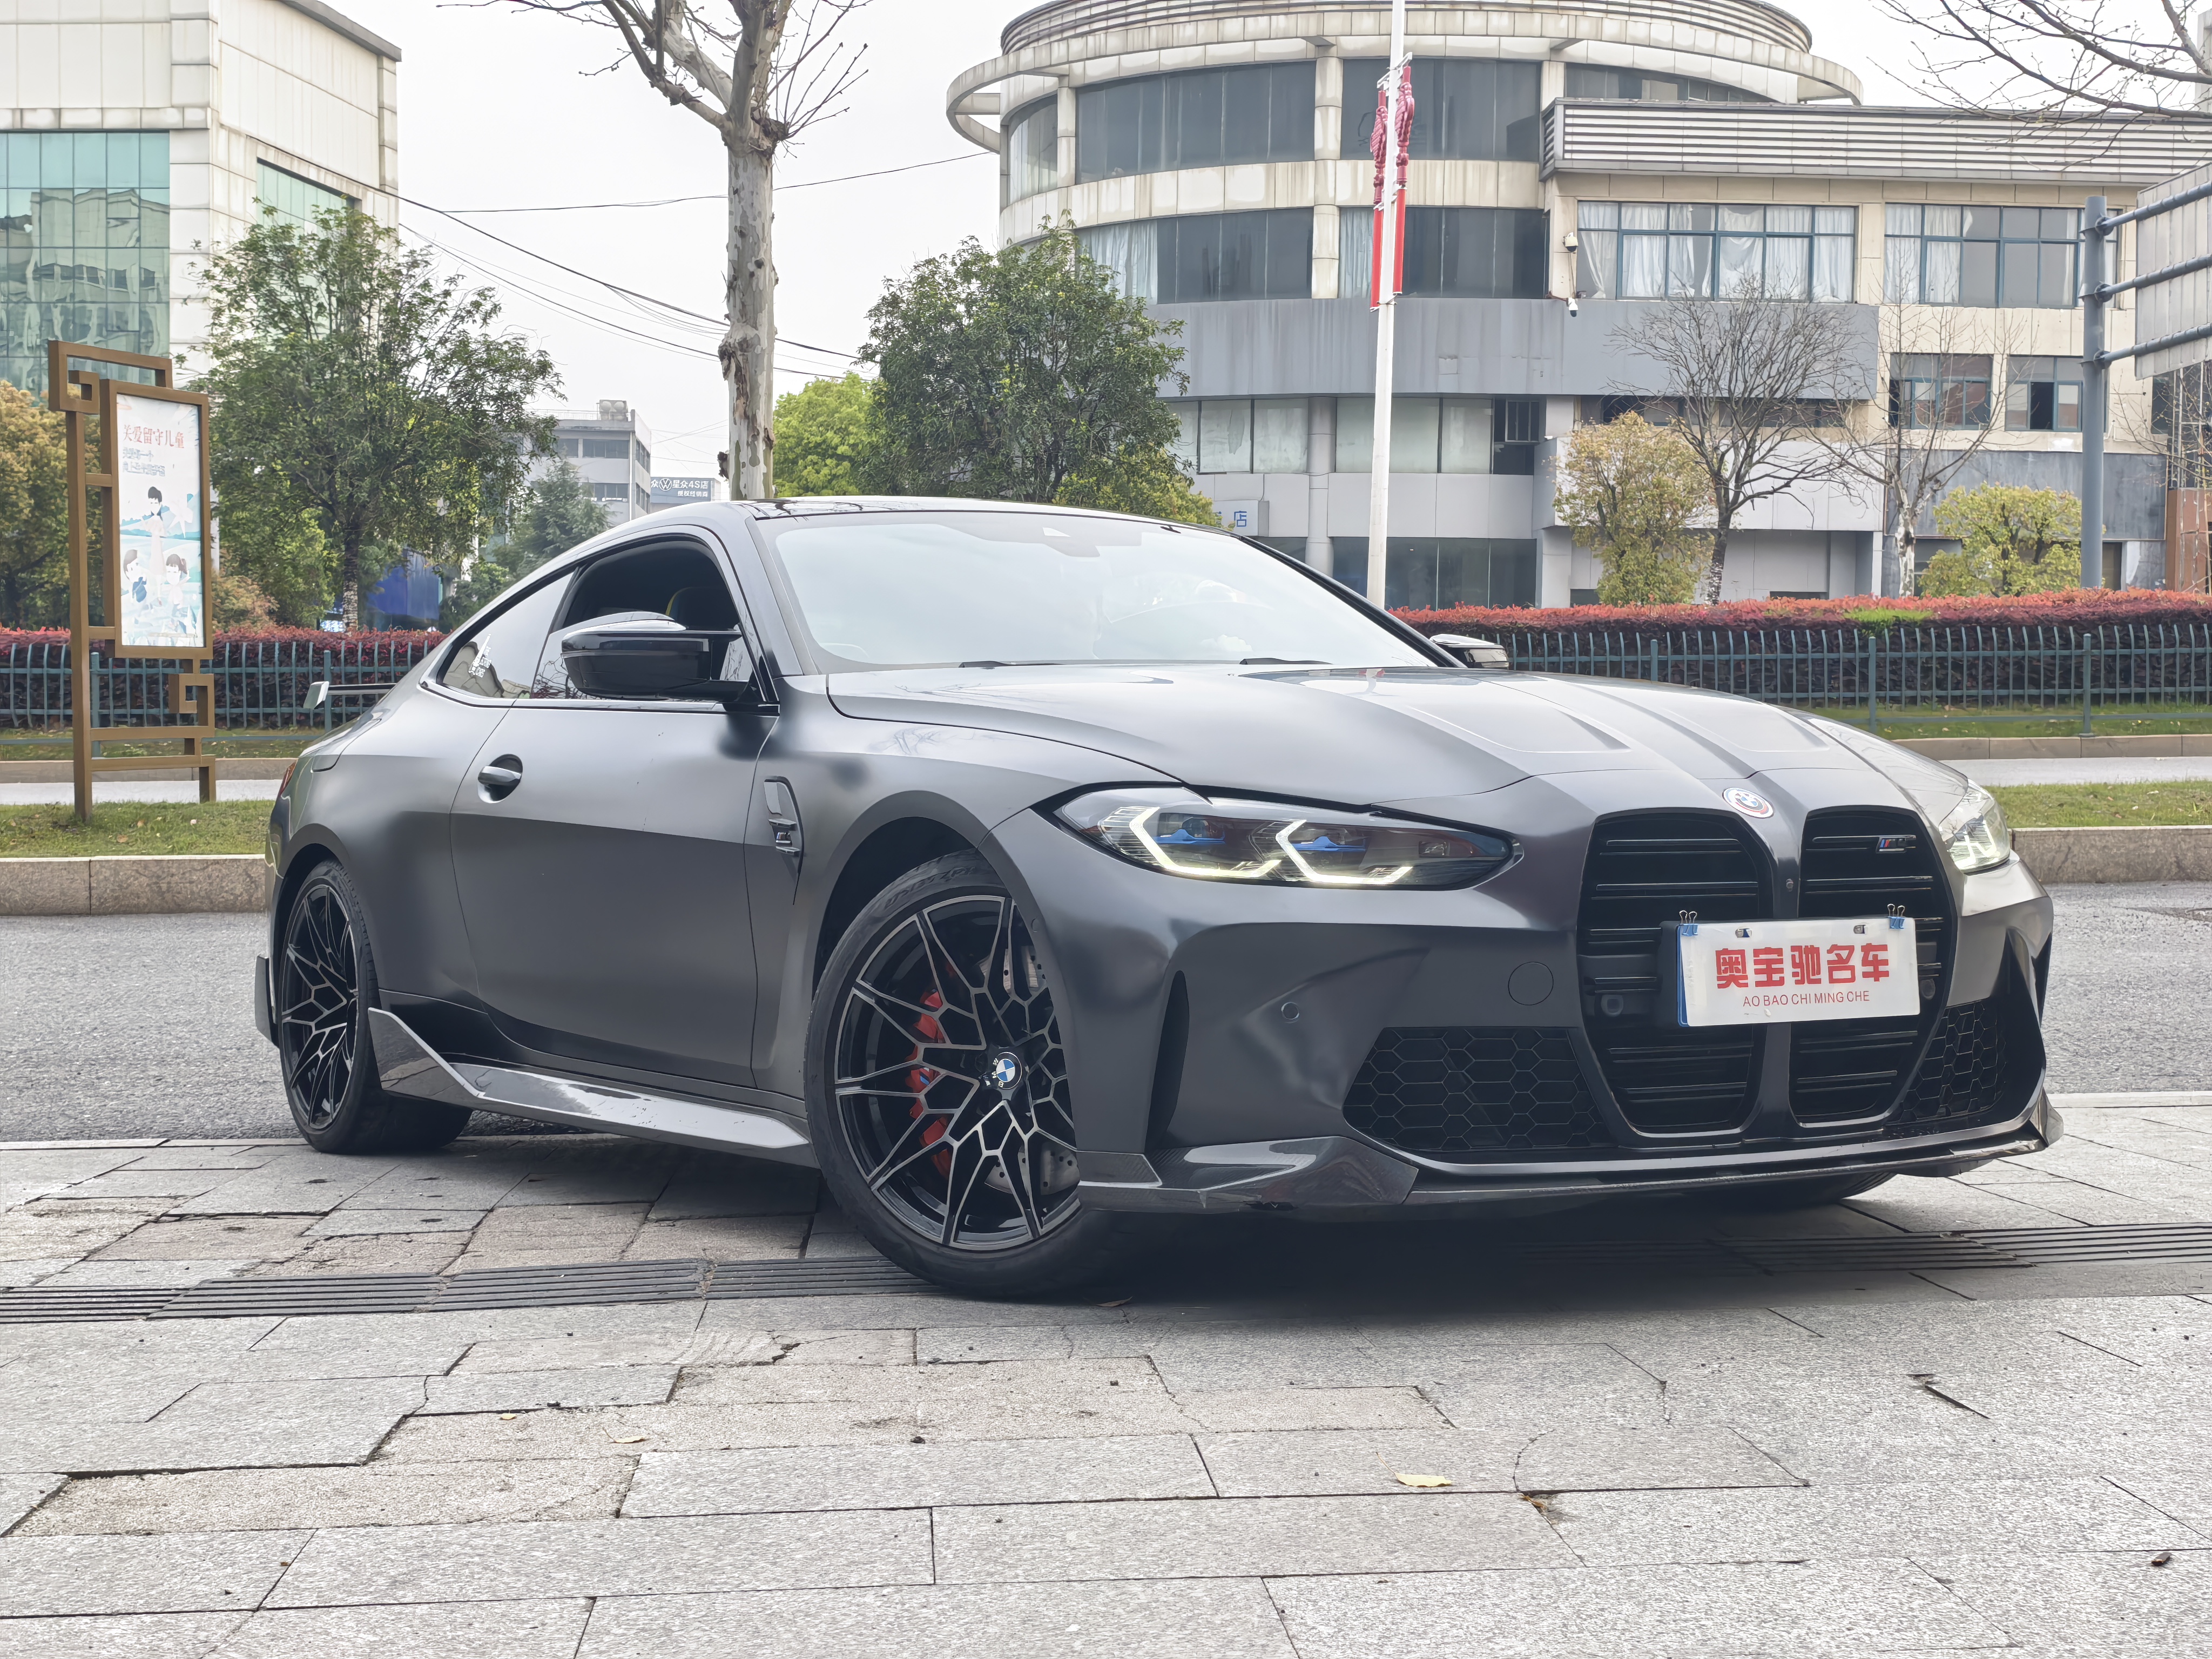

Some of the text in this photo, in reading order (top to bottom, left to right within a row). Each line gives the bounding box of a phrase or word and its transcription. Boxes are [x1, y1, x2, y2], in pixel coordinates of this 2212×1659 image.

[123, 424, 185, 449] 关爱留守儿童
[1715, 943, 1890, 989] 奥宝驰名车
[1743, 990, 1870, 1007] AO BAO CHI MING CHE
